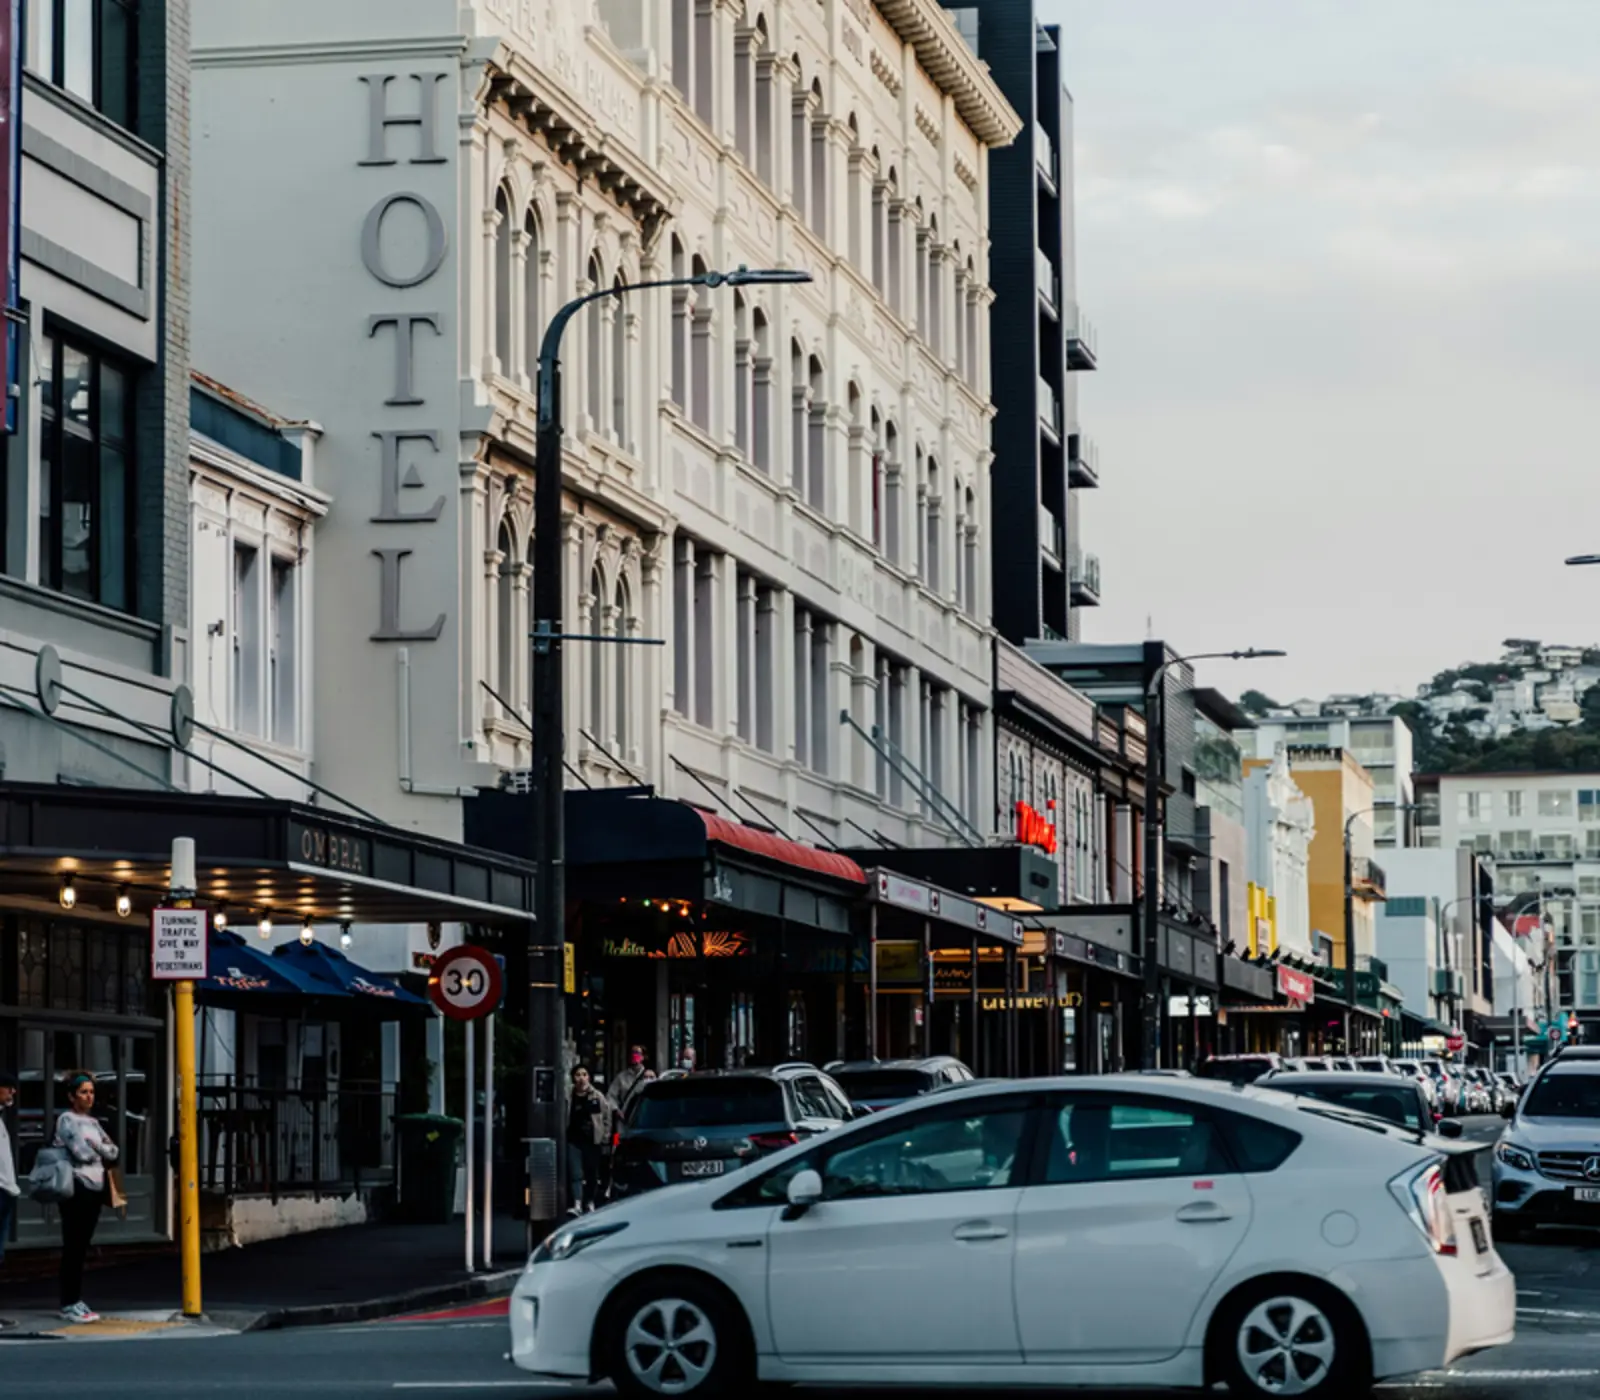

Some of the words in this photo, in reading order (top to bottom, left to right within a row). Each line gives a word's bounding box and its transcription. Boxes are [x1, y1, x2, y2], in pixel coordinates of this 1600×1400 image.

[357, 72, 449, 643] HOTEL
[301, 829, 362, 872] OMBRA
[161, 916, 197, 925] TURNING
[162, 928, 197, 937] TRAFFIC
[158, 940, 178, 949] GIVE
[183, 940, 199, 948] WAY
[174, 950, 185, 960] TO
[156, 962, 203, 971] PEDESTRIANS
[446, 968, 485, 996] 30
